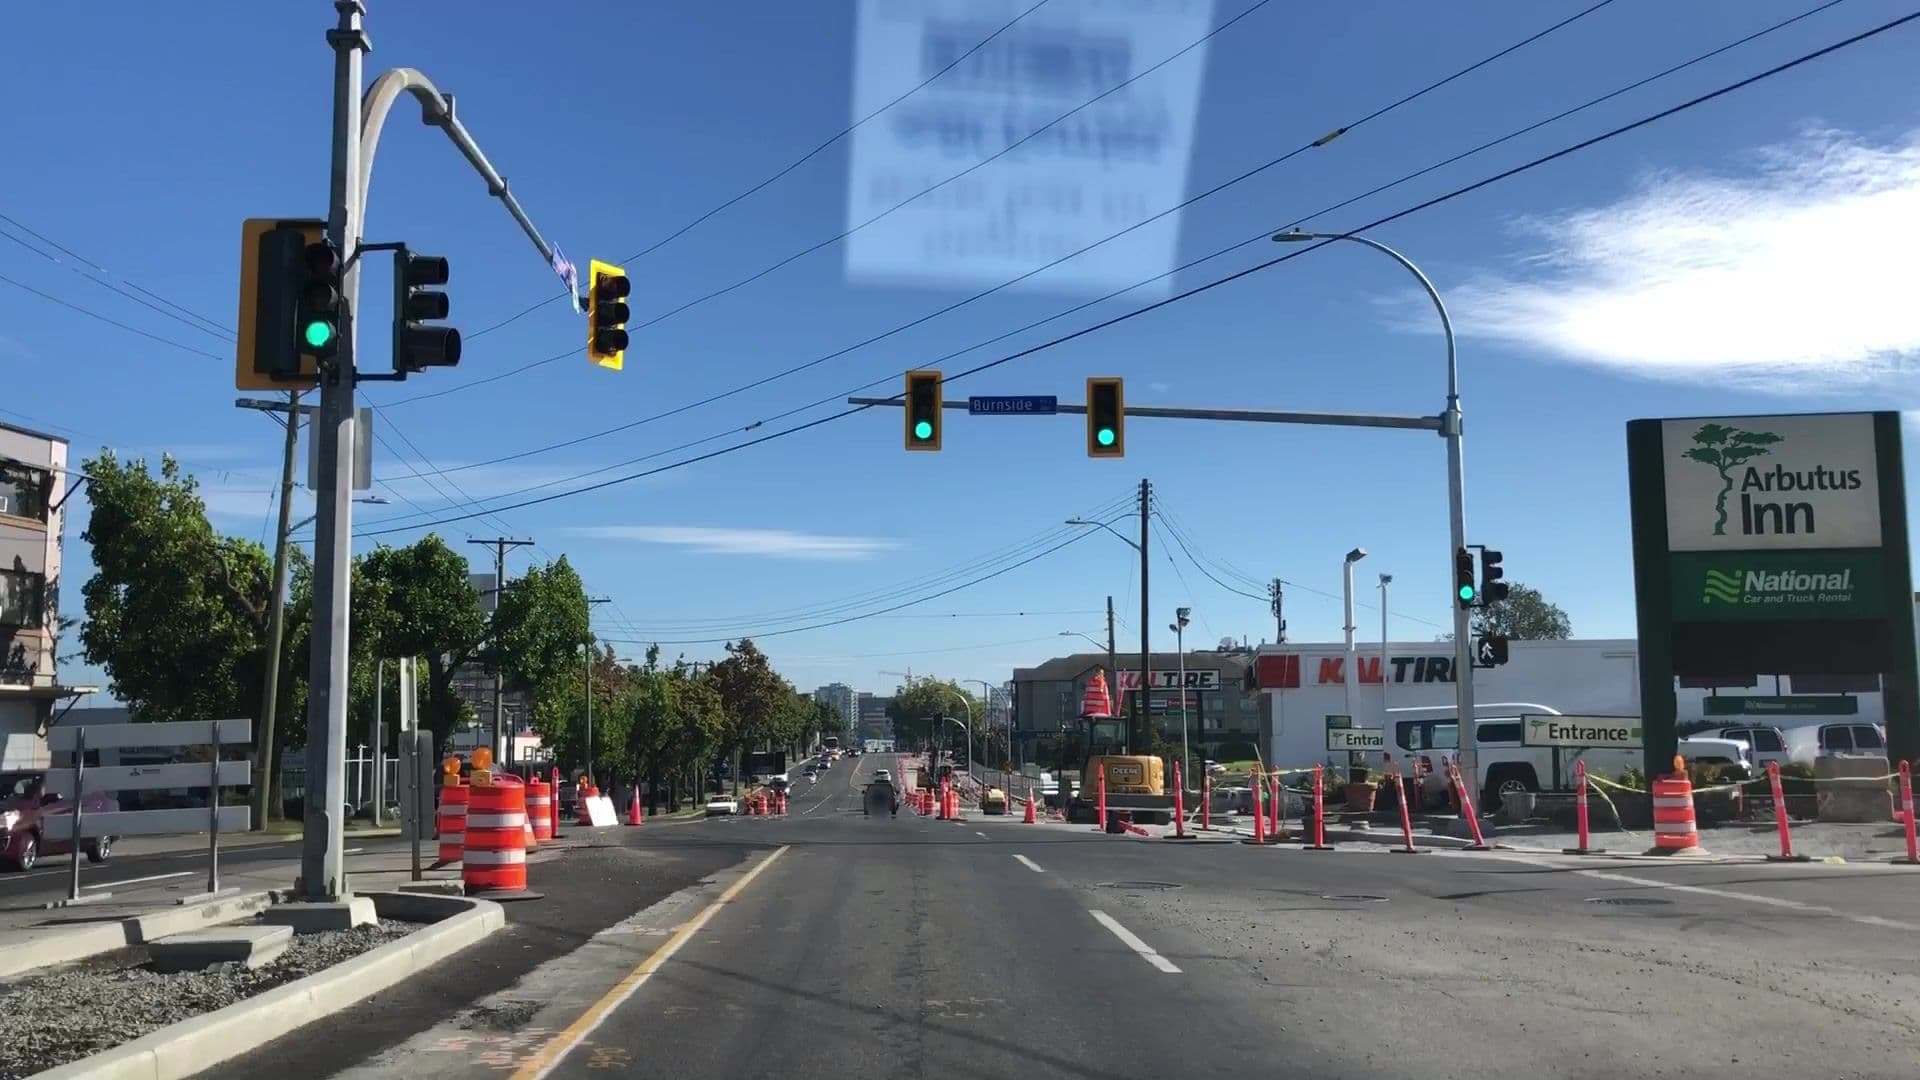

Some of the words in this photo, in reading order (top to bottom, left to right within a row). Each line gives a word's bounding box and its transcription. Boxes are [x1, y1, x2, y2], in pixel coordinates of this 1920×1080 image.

[974, 399, 1033, 411] Burnside
[1741, 463, 1861, 492] Arbutus
[1740, 493, 1815, 535] Inn
[1744, 568, 1851, 592] National
[1743, 594, 1761, 604] Car
[1763, 593, 1783, 604] and
[1787, 593, 1814, 603] Truck
[1818, 592, 1852, 602] Rental
[1163, 671, 1213, 688] TIRE
[1549, 723, 1628, 741] Entrance
